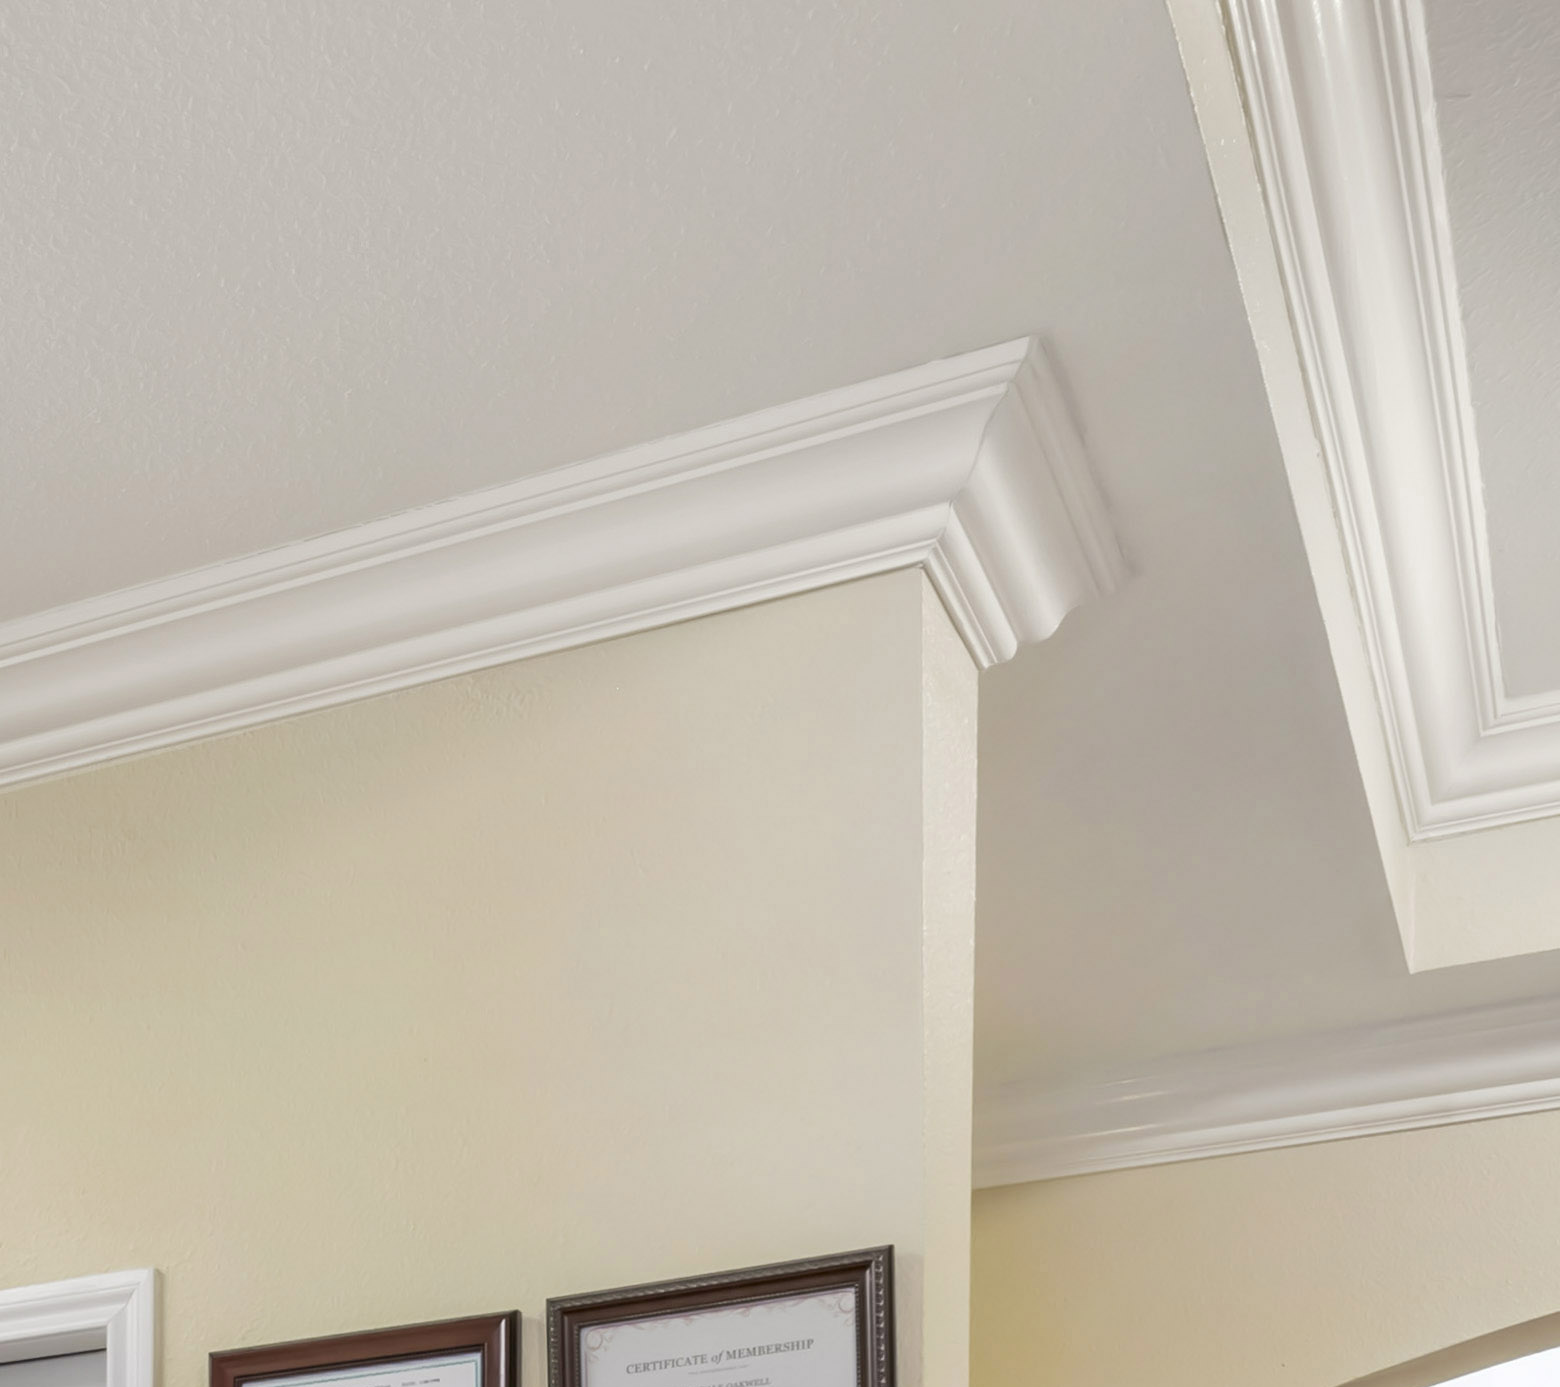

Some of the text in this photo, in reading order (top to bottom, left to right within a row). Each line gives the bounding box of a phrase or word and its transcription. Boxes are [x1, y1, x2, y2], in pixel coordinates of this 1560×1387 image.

[626, 1354, 708, 1374] CERTIFICATE
[711, 1350, 724, 1364] of
[726, 1339, 815, 1361] MEMBERSHIP
